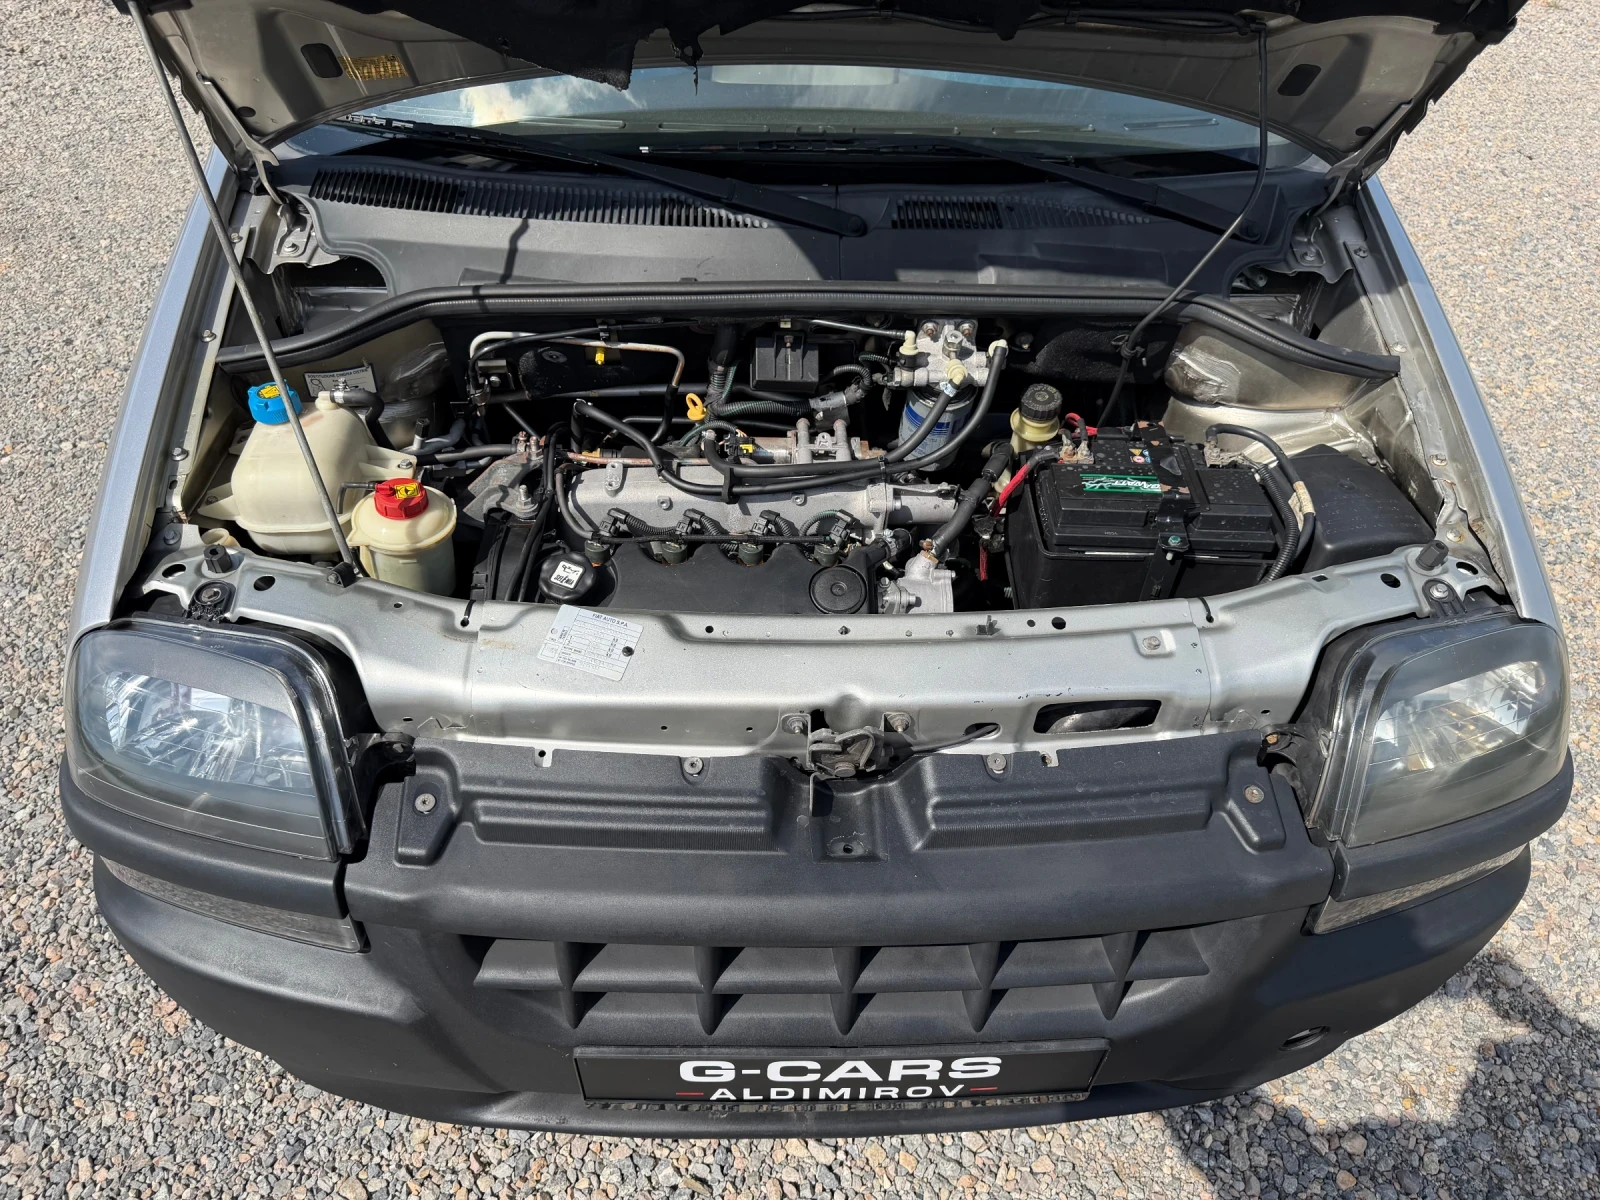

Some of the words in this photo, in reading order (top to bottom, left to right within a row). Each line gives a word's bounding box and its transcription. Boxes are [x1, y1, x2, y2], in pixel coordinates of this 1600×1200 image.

[1111, 480, 1161, 489] GAWATT
[679, 1056, 1003, 1083] G-CARS
[709, 1084, 965, 1101] ALDIMIROV
